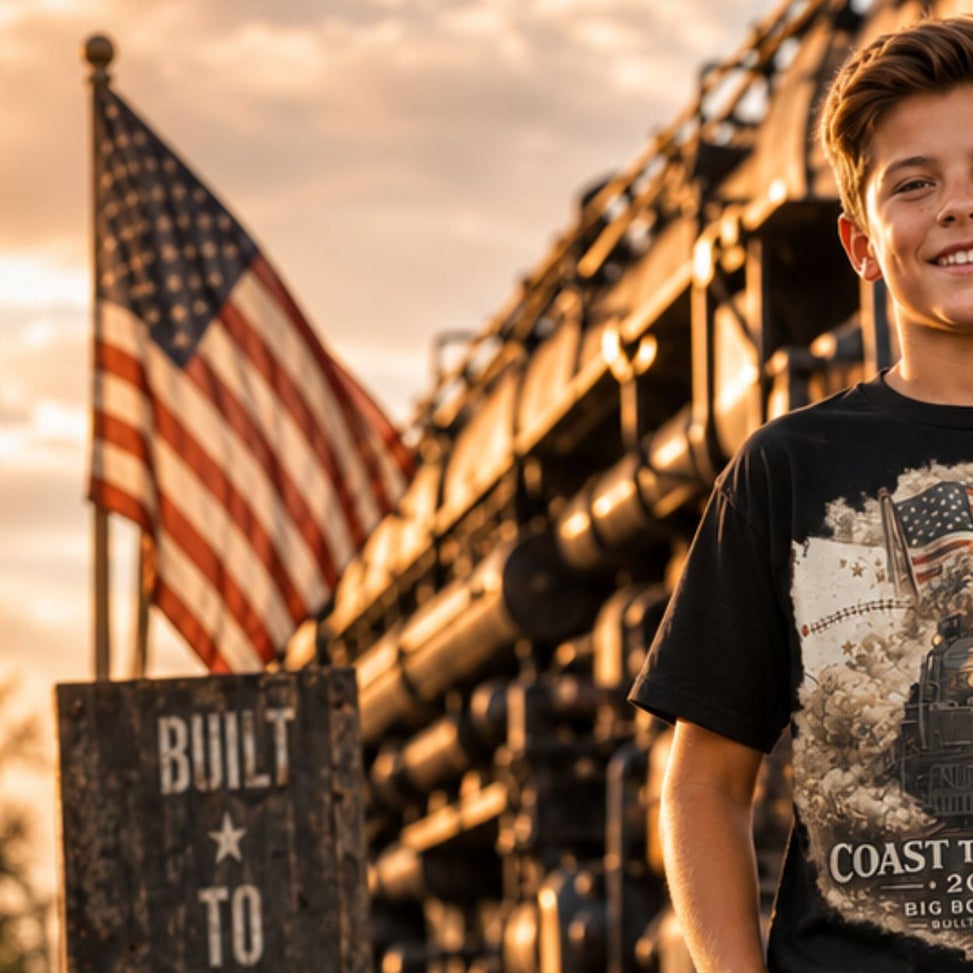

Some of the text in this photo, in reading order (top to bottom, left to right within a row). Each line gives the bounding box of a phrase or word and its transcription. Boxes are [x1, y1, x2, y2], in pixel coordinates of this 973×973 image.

[157, 709, 296, 796] BUILT
[829, 840, 950, 883] COAST
[199, 884, 264, 967] TO
[904, 901, 943, 917] BIG
